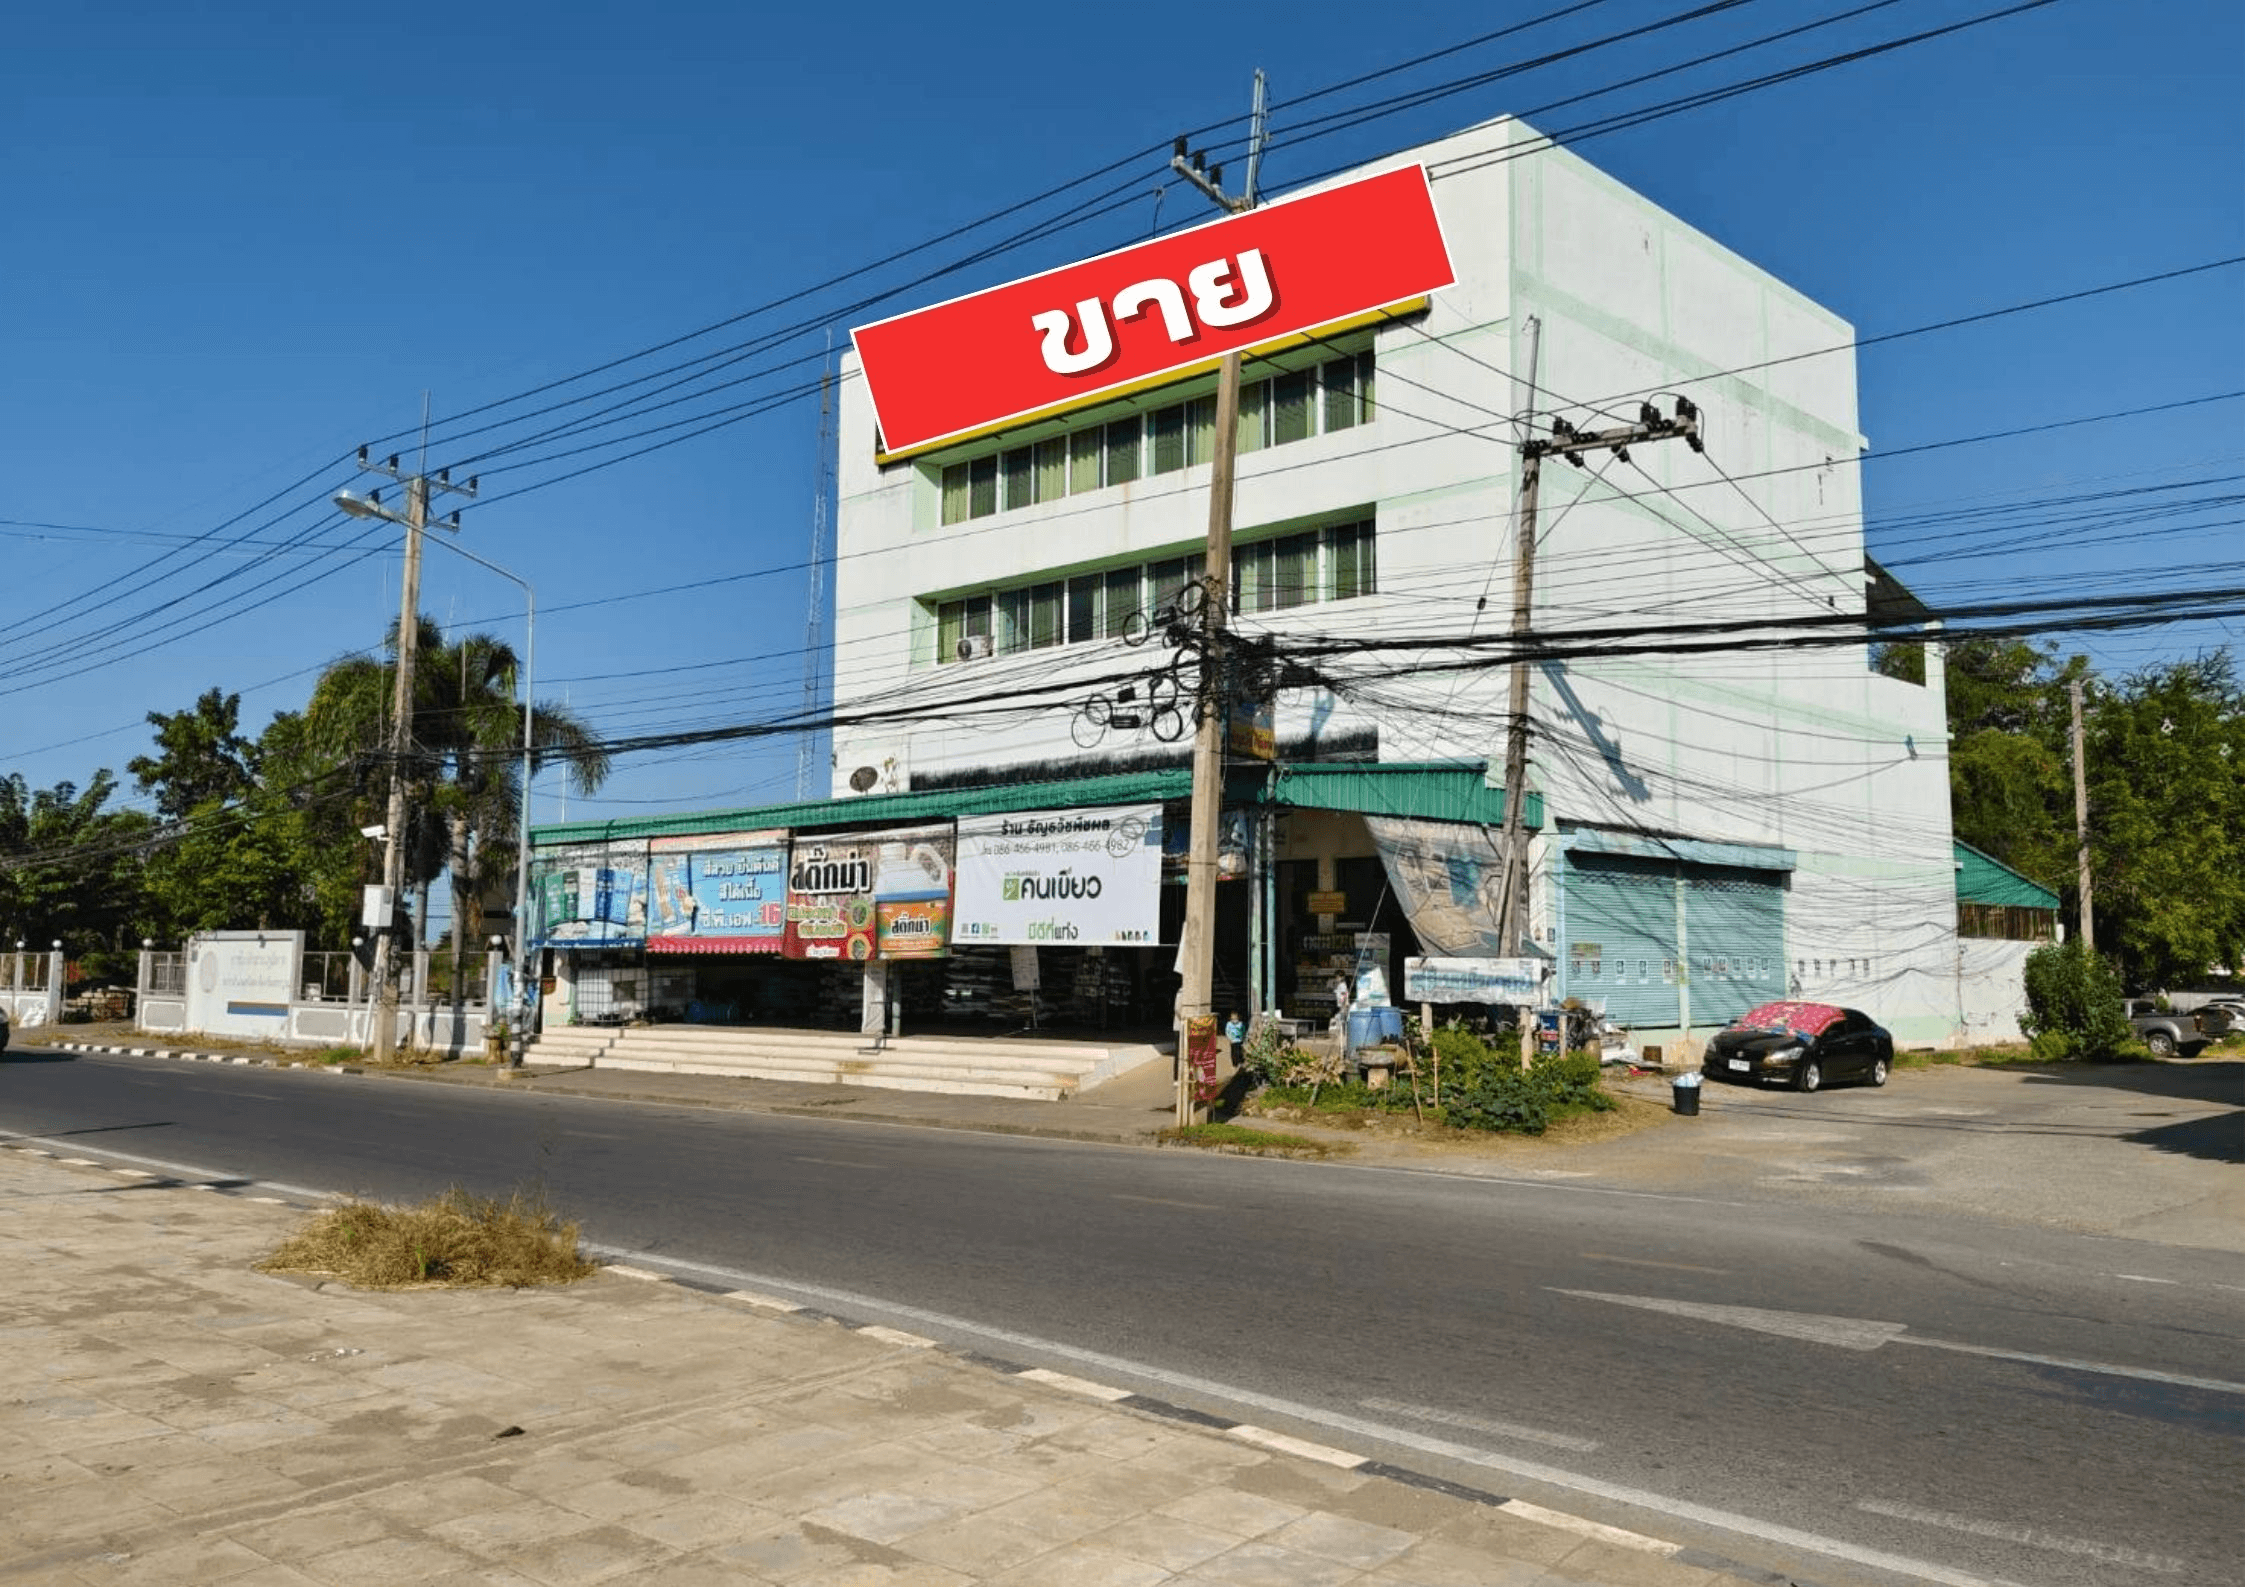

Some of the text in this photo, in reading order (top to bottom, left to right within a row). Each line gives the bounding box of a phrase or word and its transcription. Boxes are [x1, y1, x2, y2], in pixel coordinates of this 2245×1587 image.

[1001, 819, 1022, 836] ร้าน
[1021, 867, 1102, 900] คนเขียว
